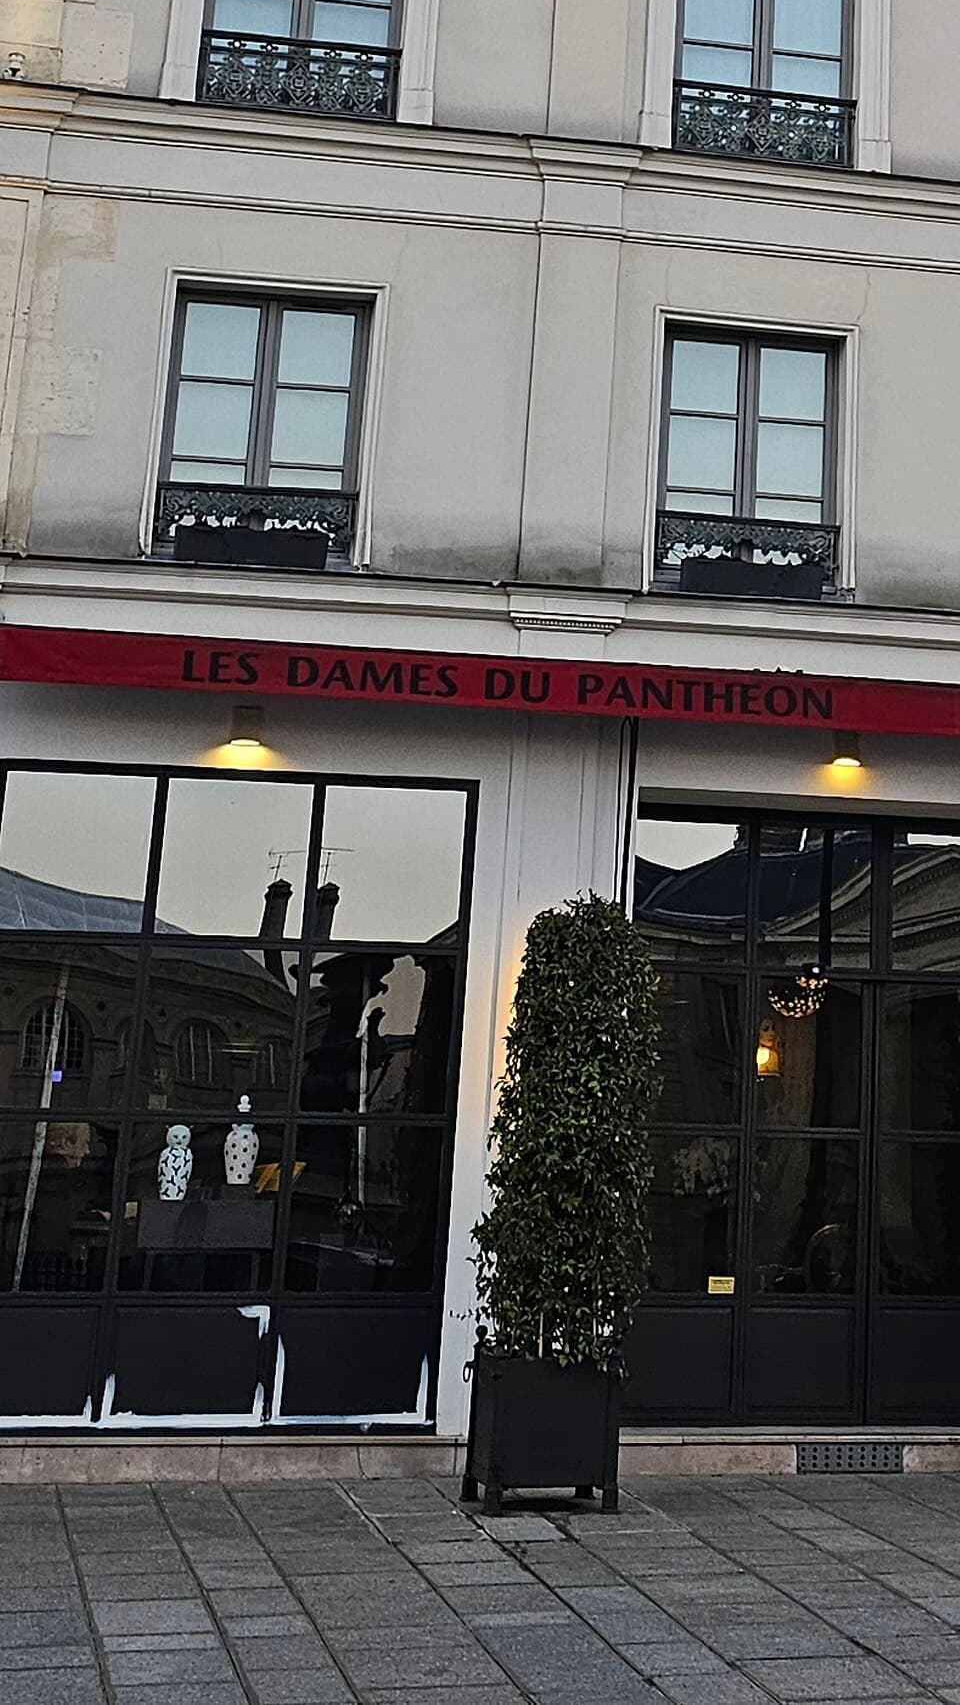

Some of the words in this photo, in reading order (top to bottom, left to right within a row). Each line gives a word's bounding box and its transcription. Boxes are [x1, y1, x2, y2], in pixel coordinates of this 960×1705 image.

[182, 650, 259, 685] LES
[287, 656, 459, 697] DAMES
[483, 668, 550, 703] DU
[576, 674, 833, 719] PANTHEON
